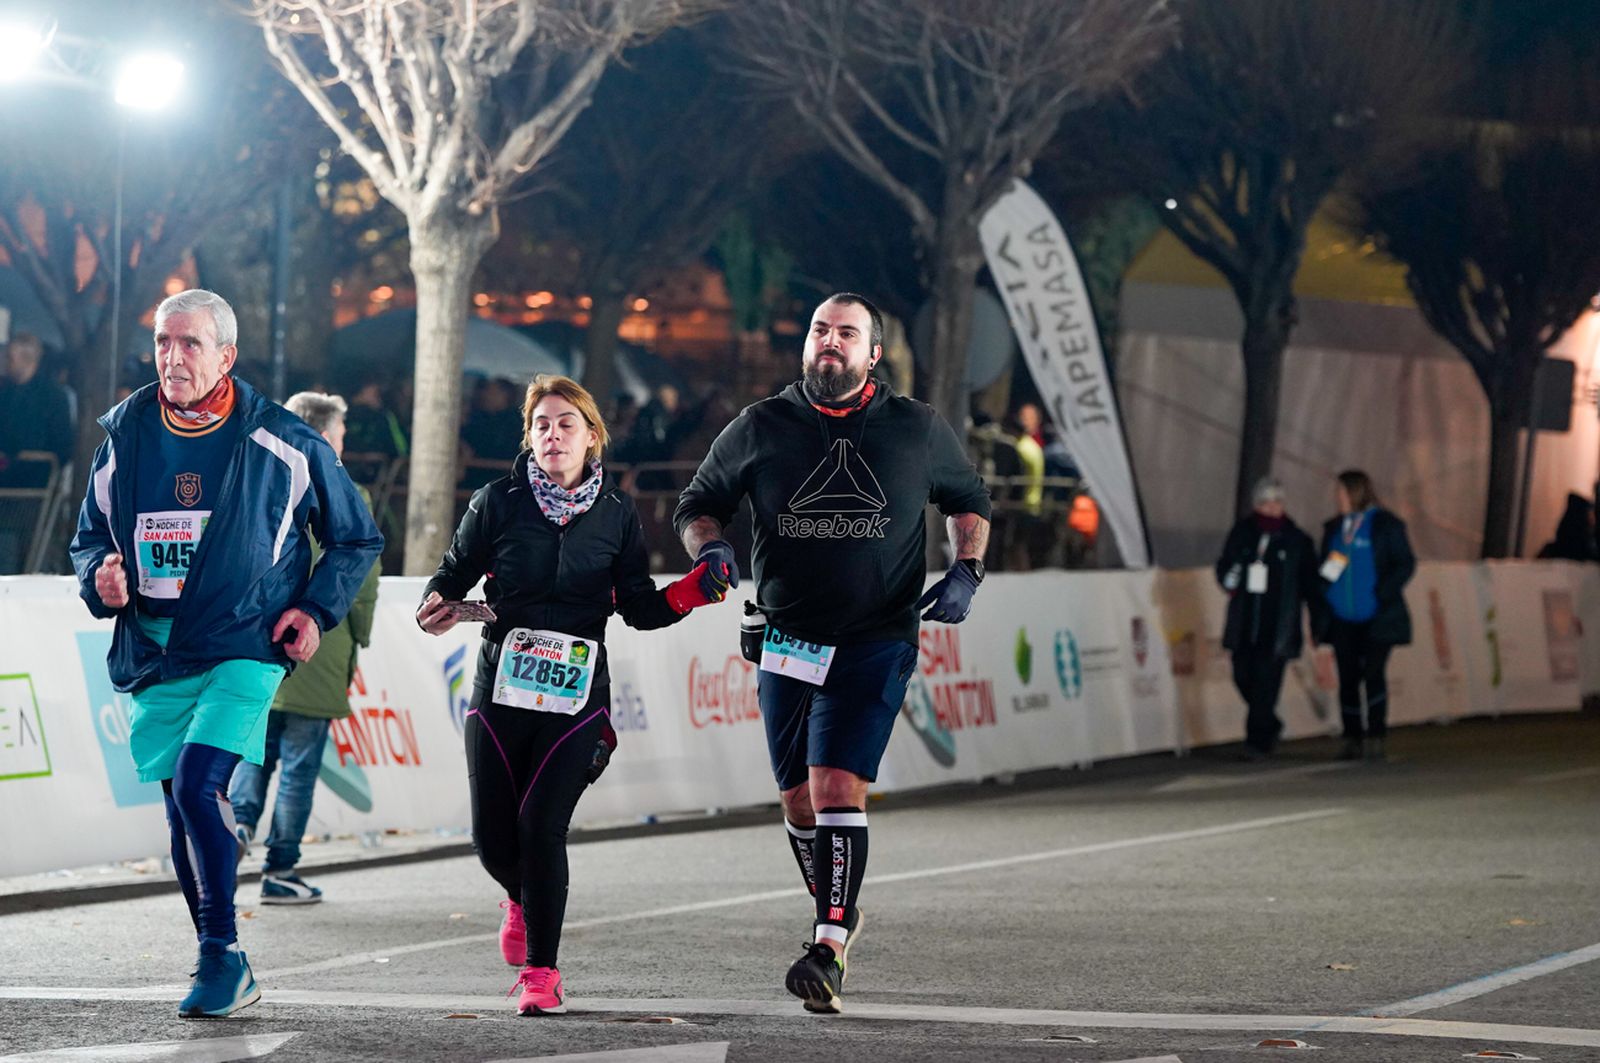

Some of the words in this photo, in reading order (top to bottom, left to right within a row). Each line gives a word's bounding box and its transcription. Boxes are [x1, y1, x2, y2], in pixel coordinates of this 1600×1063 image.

[1025, 222, 1112, 426] JAPEMASA
[143, 531, 161, 541] SAN
[155, 520, 180, 530] NOCHE
[181, 520, 193, 530] DE
[777, 513, 891, 539] Reebok
[151, 541, 196, 568] 945
[525, 636, 553, 649] NOCHE
[553, 641, 565, 652] DE
[532, 647, 563, 661] ANTÓN
[918, 625, 961, 676] SAN
[511, 654, 582, 690] 12852
[329, 688, 422, 768] ANTÓN
